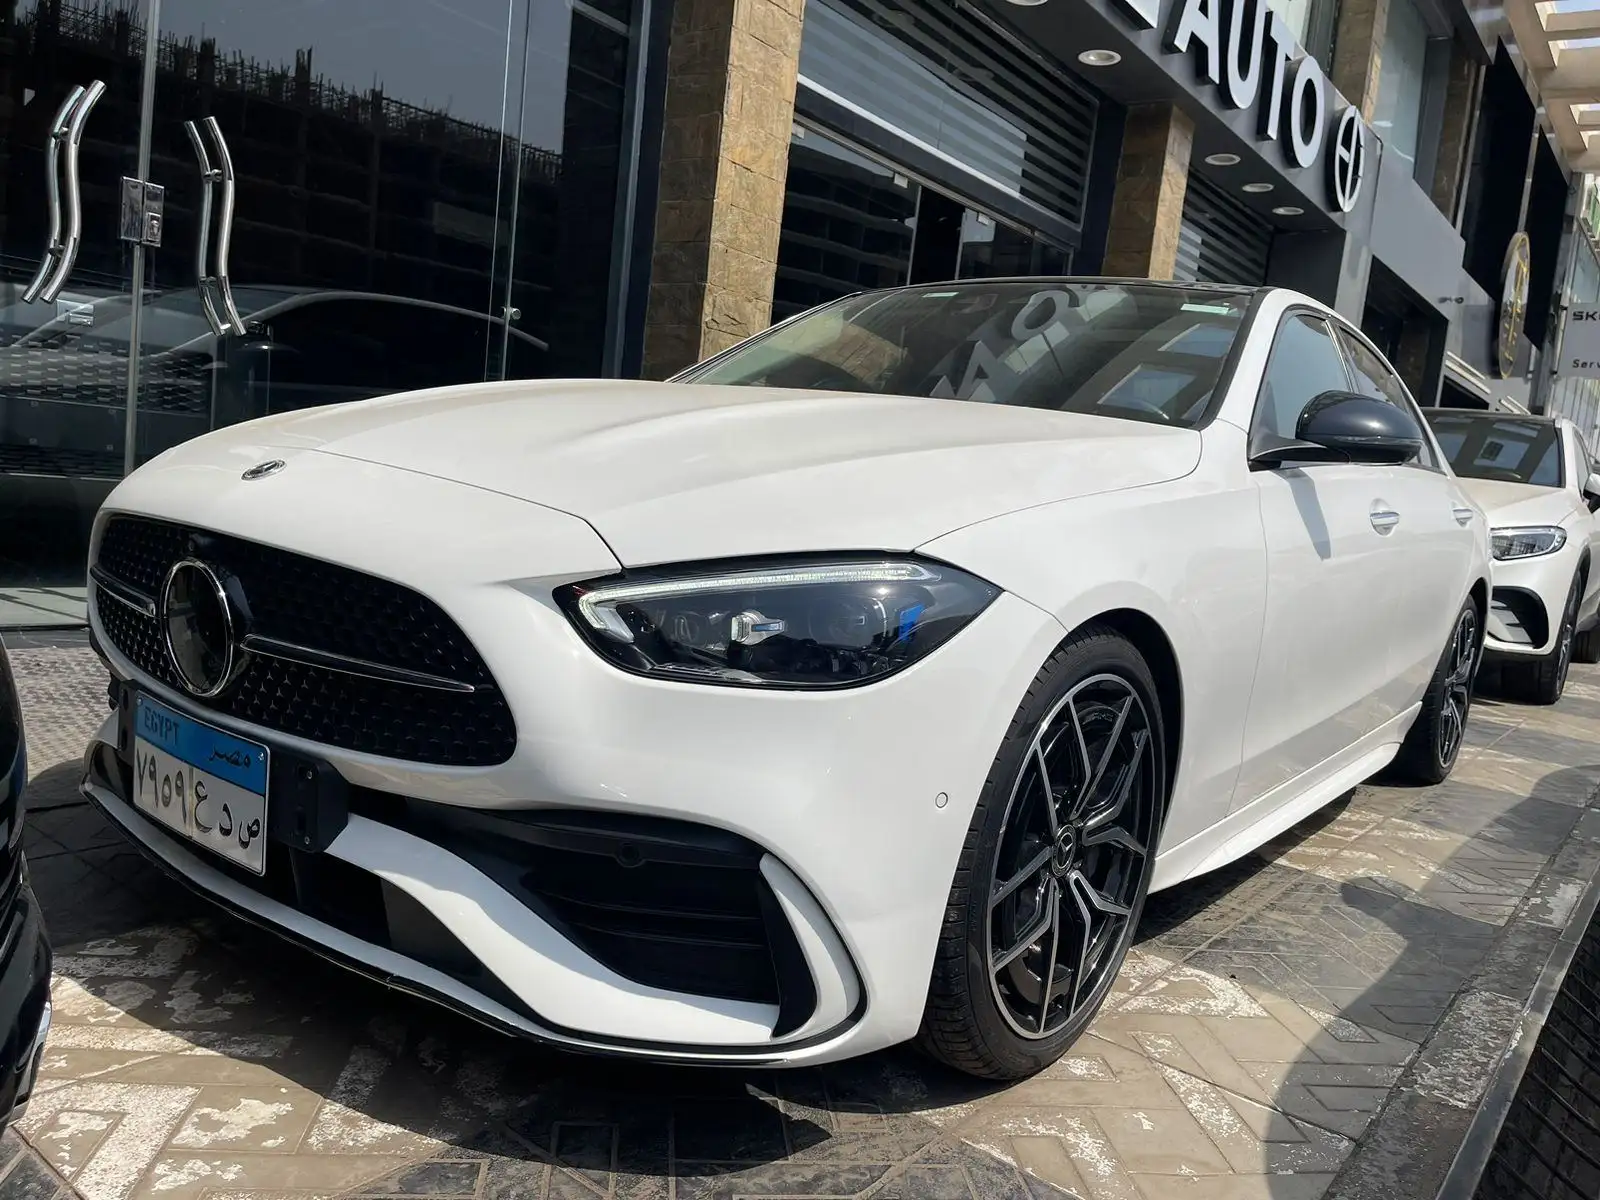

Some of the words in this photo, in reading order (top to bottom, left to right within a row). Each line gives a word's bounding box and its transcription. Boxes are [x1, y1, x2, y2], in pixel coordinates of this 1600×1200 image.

[1174, 0, 1324, 168] AUTO
[1572, 310, 1600, 321] SK
[144, 706, 180, 747] EGYPT
[208, 742, 251, 769] مصر
